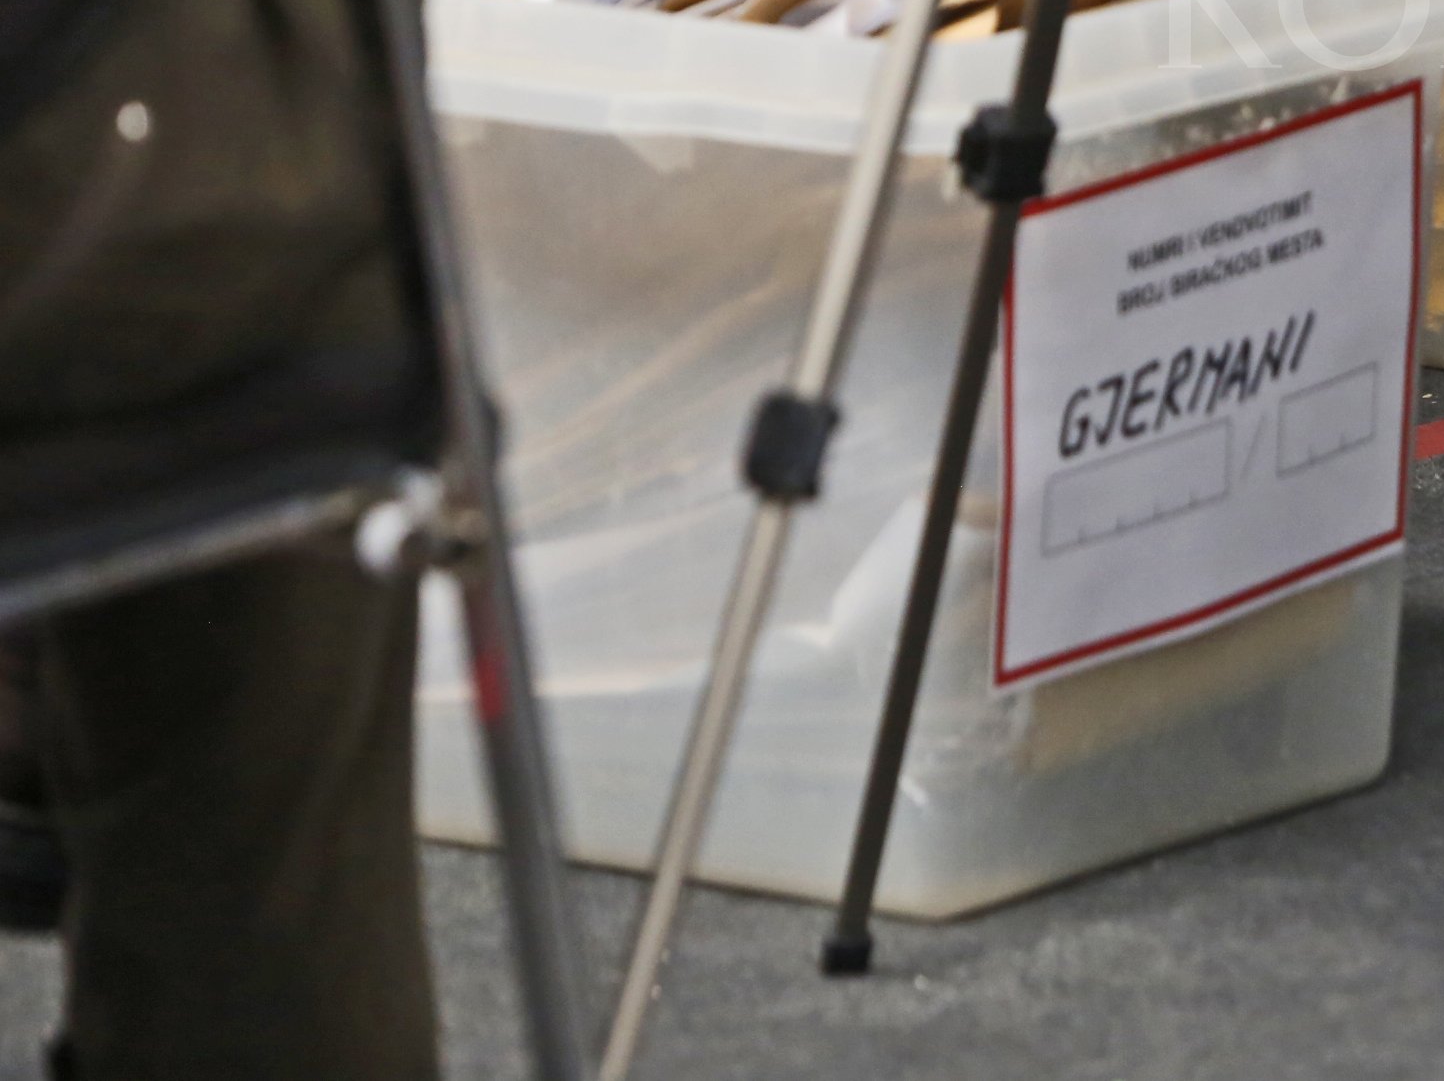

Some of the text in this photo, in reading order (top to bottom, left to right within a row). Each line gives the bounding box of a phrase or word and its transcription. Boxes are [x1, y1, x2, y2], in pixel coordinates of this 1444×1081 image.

[1117, 280, 1166, 315] BROJ
[1268, 228, 1325, 265] MESTA
[1127, 235, 1185, 271] NUMRI
[1059, 310, 1316, 459] GJERMANI
